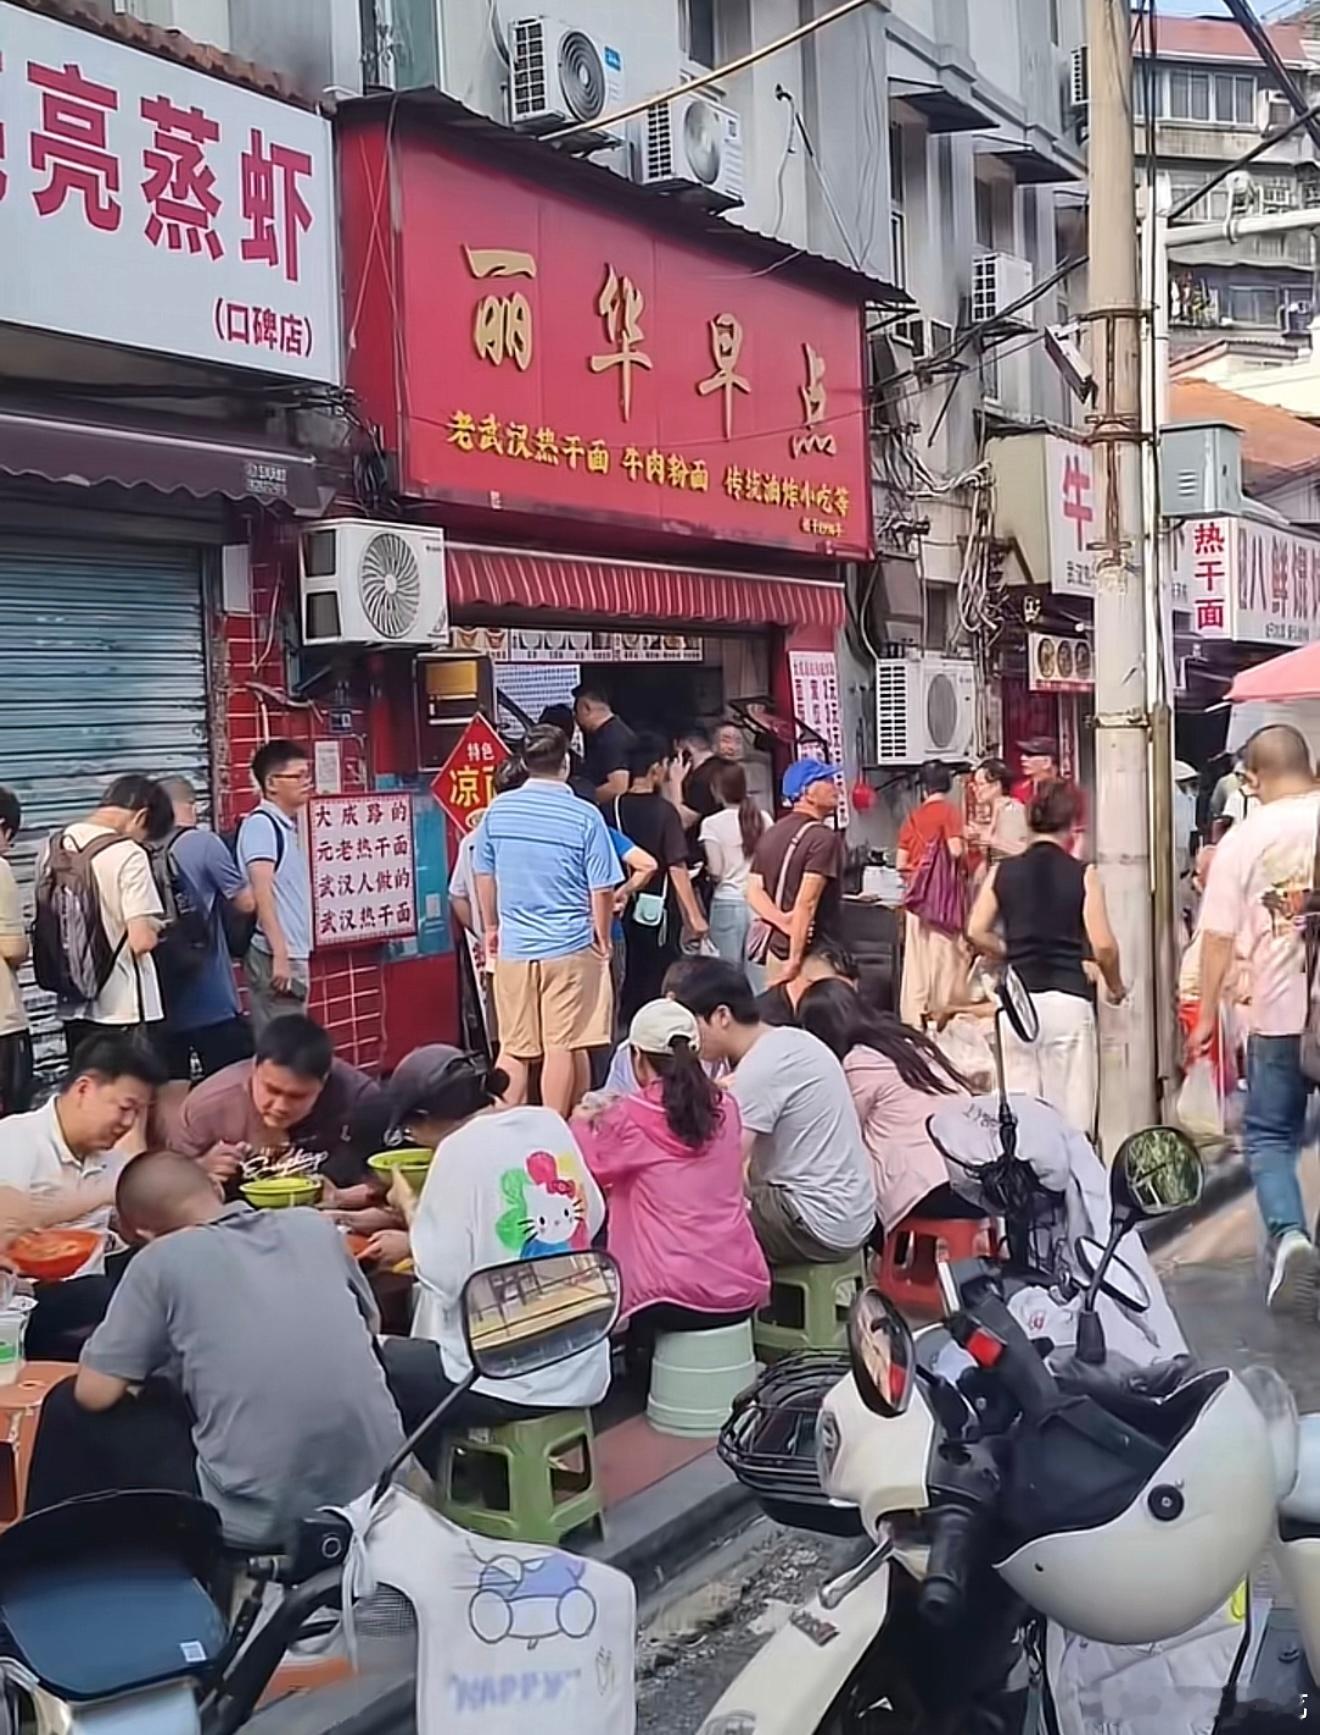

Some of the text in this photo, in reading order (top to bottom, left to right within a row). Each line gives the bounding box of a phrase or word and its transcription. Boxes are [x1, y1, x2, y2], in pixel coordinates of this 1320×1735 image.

[0, 50, 313, 282] 亮蒸虾
[461, 243, 838, 460] 丽华早点
[447, 410, 610, 474] 老武汉热干面
[622, 446, 710, 492] 牛肉粉面
[1194, 522, 1225, 630] 热干面
[467, 742, 495, 762] 特色
[316, 801, 407, 828] 大成路的
[317, 834, 408, 862] 元老热干面
[318, 867, 410, 899] 武汉人做的
[320, 901, 411, 935] 武汉热干面
